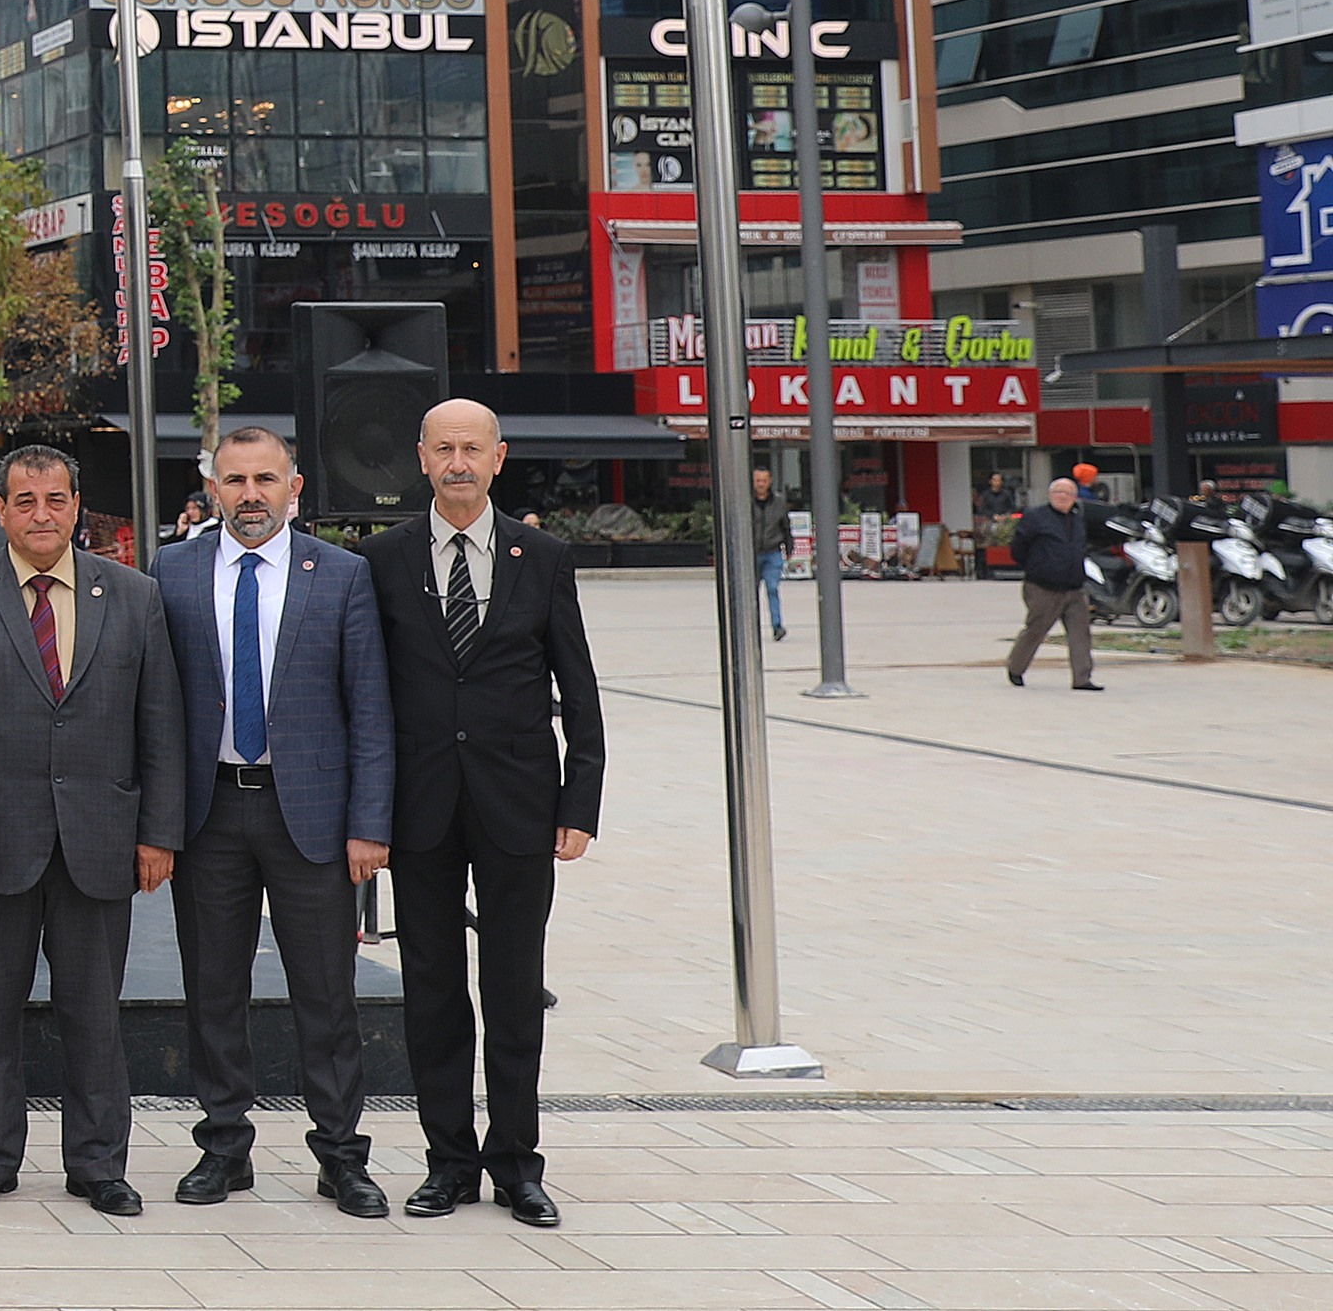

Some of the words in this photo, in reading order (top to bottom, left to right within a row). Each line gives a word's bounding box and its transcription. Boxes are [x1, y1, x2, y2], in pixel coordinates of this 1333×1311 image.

[175, 8, 475, 52] İSTANBUL
[179, 196, 406, 229] ESOĞLU
[147, 226, 171, 359] EBAP
[901, 327, 922, 362] &
[945, 314, 1033, 368] Çorba
[677, 374, 1029, 407] LKANTA
